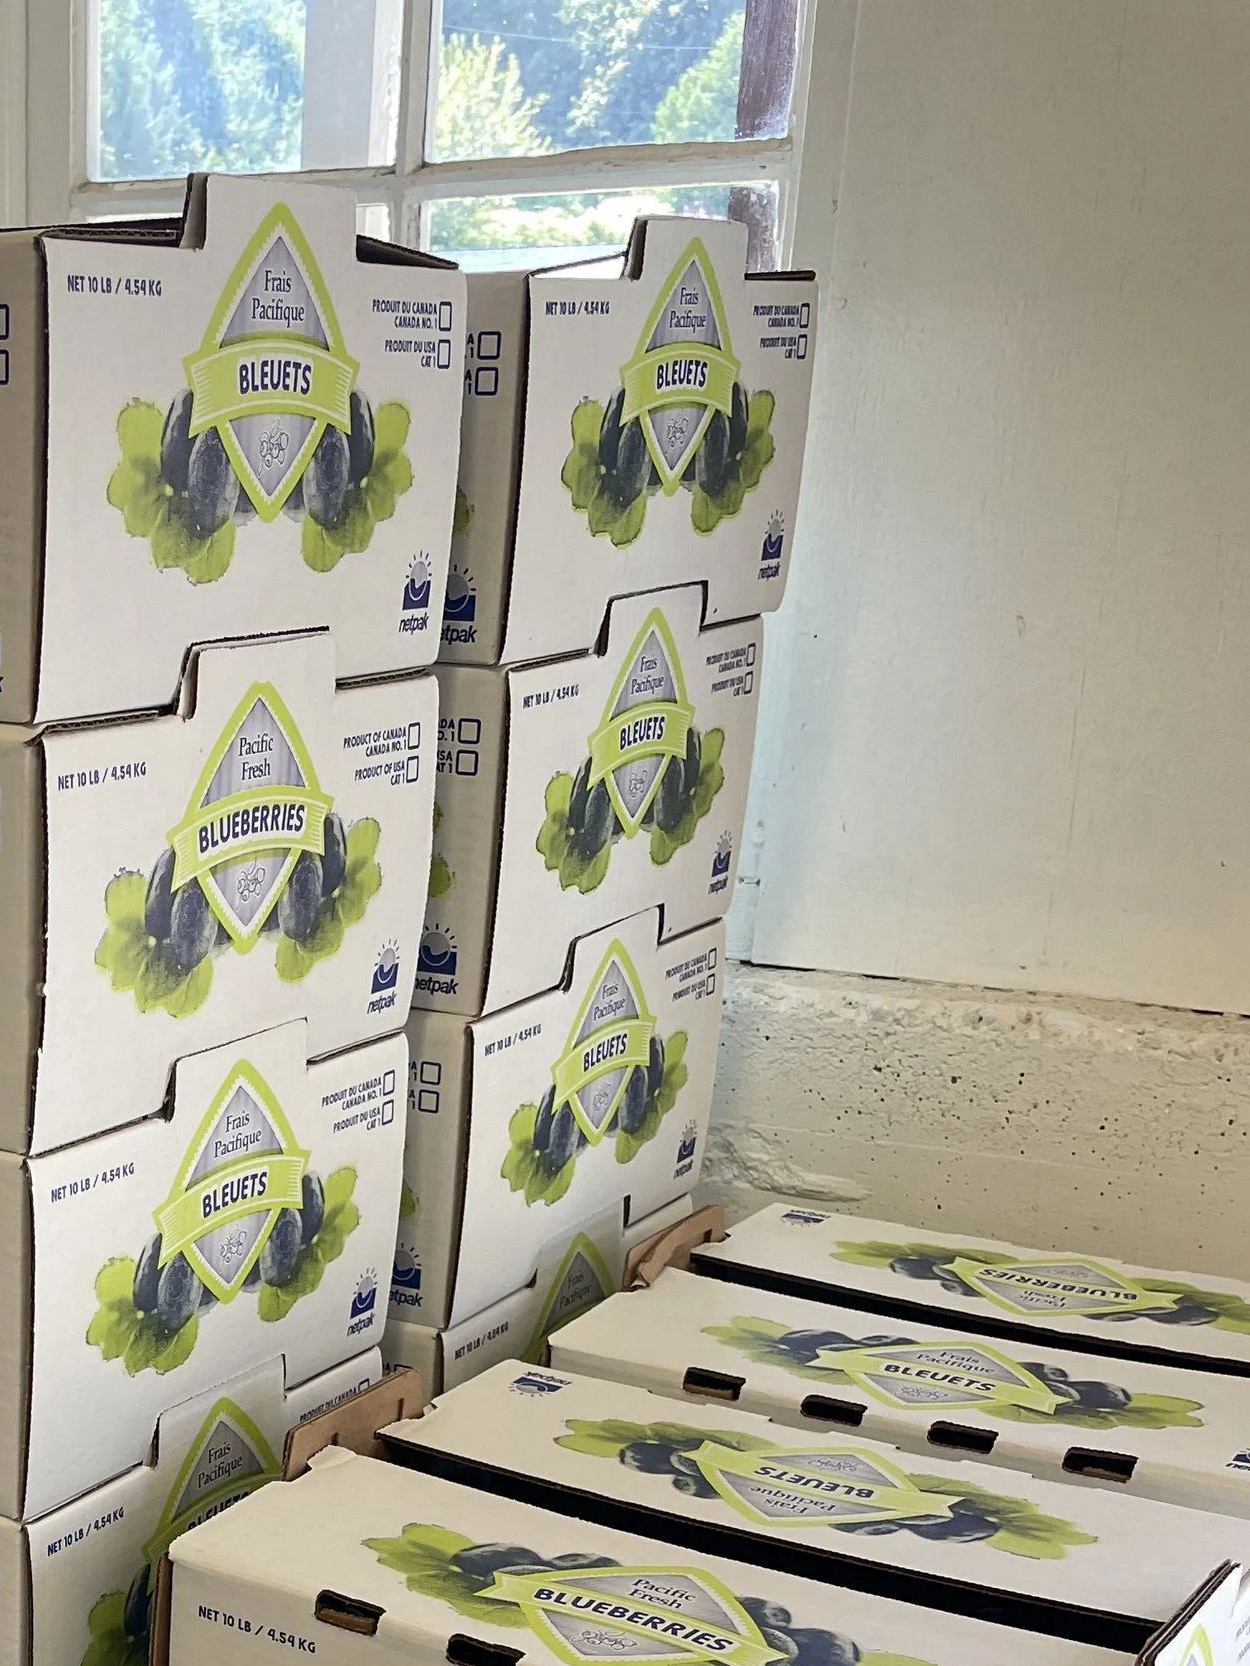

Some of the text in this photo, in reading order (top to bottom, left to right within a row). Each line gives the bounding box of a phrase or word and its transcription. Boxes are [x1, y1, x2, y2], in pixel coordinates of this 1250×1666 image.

[265, 270, 291, 292] Frais
[252, 298, 304, 328] Pacifique
[240, 360, 311, 395] BLEUETS
[657, 360, 707, 389] BLEUETS
[399, 612, 429, 635] netpak
[239, 733, 273, 756] Pacific
[620, 717, 665, 750] BLEUETS
[242, 758, 270, 780] Fresh
[199, 803, 305, 853] BLUEBERRIES
[367, 991, 397, 1014] netpak
[584, 1034, 629, 1073] BLEUETS
[226, 1110, 249, 1132] Frais
[214, 1131, 261, 1158] Pacifique
[203, 1172, 268, 1218] BLEUETS
[976, 1265, 1137, 1304] BLUEBERRIES
[347, 1313, 375, 1336] netpak
[885, 1360, 995, 1396] BLEUETS
[209, 1442, 230, 1463] Frais
[198, 1452, 244, 1488] Pacifique
[754, 1461, 875, 1501] BLEUETS
[629, 1587, 684, 1610] Fresh
[633, 1577, 696, 1602] Pacific
[199, 1606, 219, 1622] NET
[223, 1613, 234, 1626] 10
[238, 1618, 251, 1632] LB
[268, 1629, 294, 1647] 4.54
[299, 1638, 315, 1653] KG
[534, 1585, 736, 1655] BLUEBERRIES
